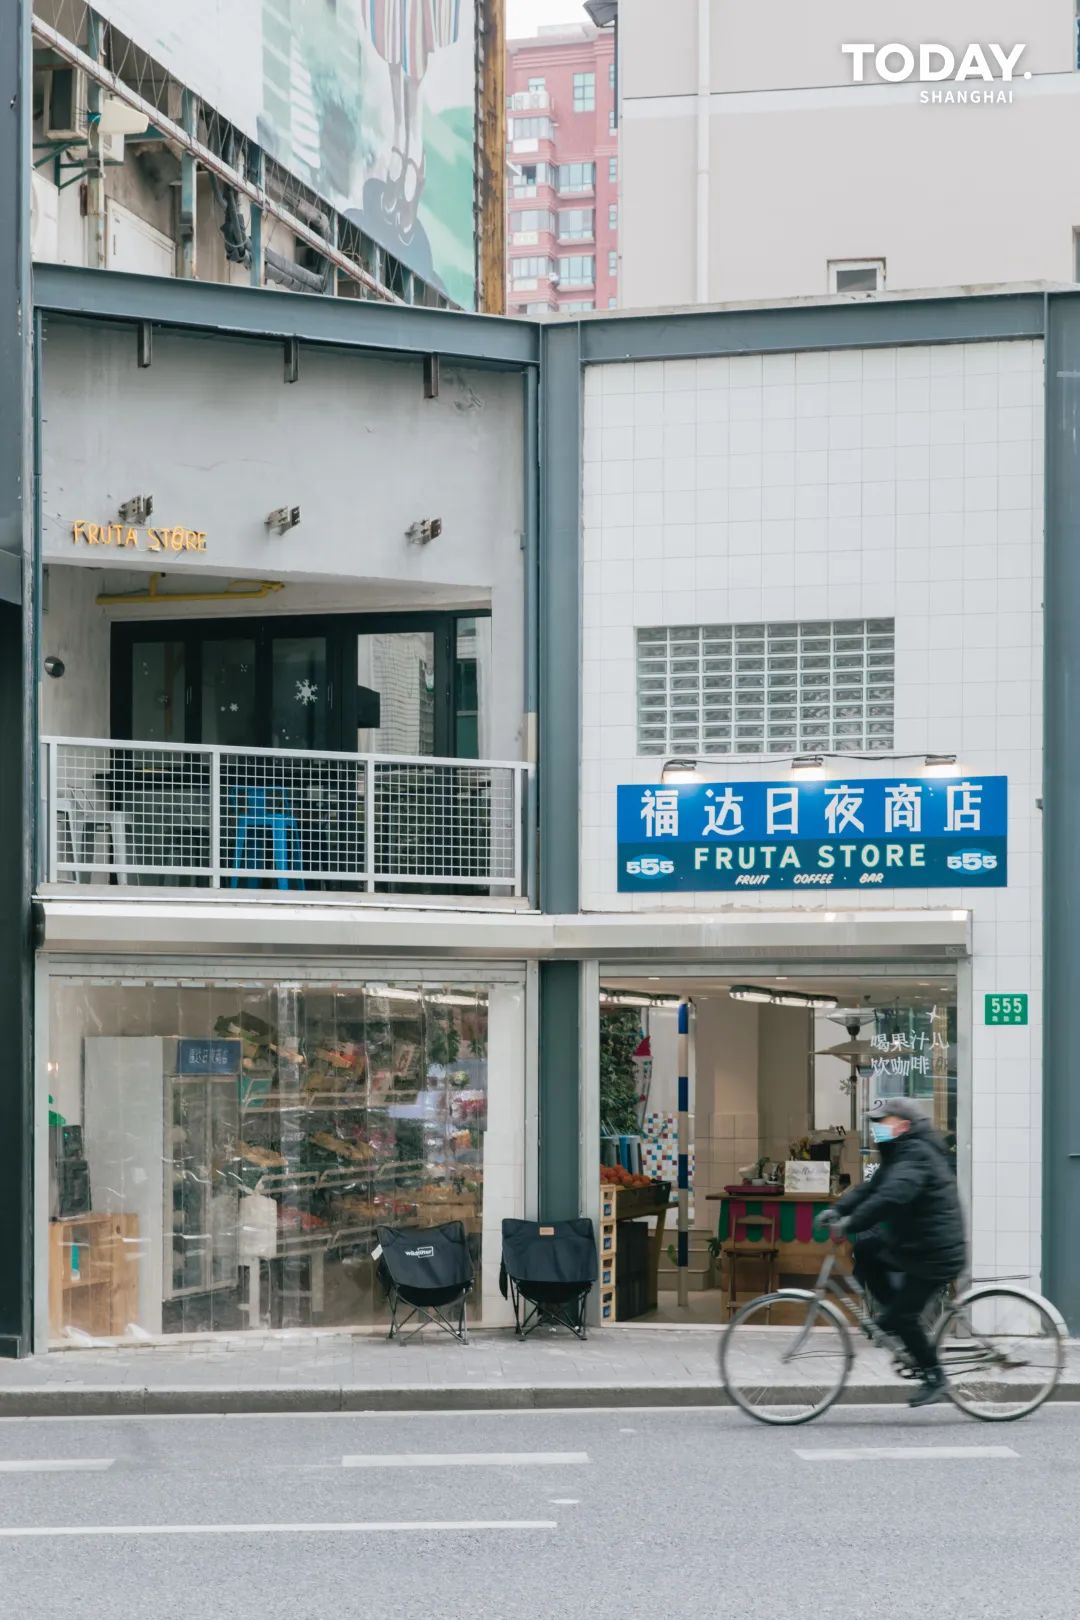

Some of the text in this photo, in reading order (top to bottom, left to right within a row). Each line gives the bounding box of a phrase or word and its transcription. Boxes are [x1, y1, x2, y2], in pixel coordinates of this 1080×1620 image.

[72, 519, 208, 552] FRUTA STORE
[640, 782, 983, 837] 福达日夜商店
[694, 843, 926, 870] FRUTA STORE
[947, 853, 998, 871] 555
[626, 858, 674, 876] 555
[735, 872, 884, 885] FRUIT COFFEE BAR
[991, 997, 1022, 1013] 555
[870, 1055, 930, 1077] 饮咖啡
